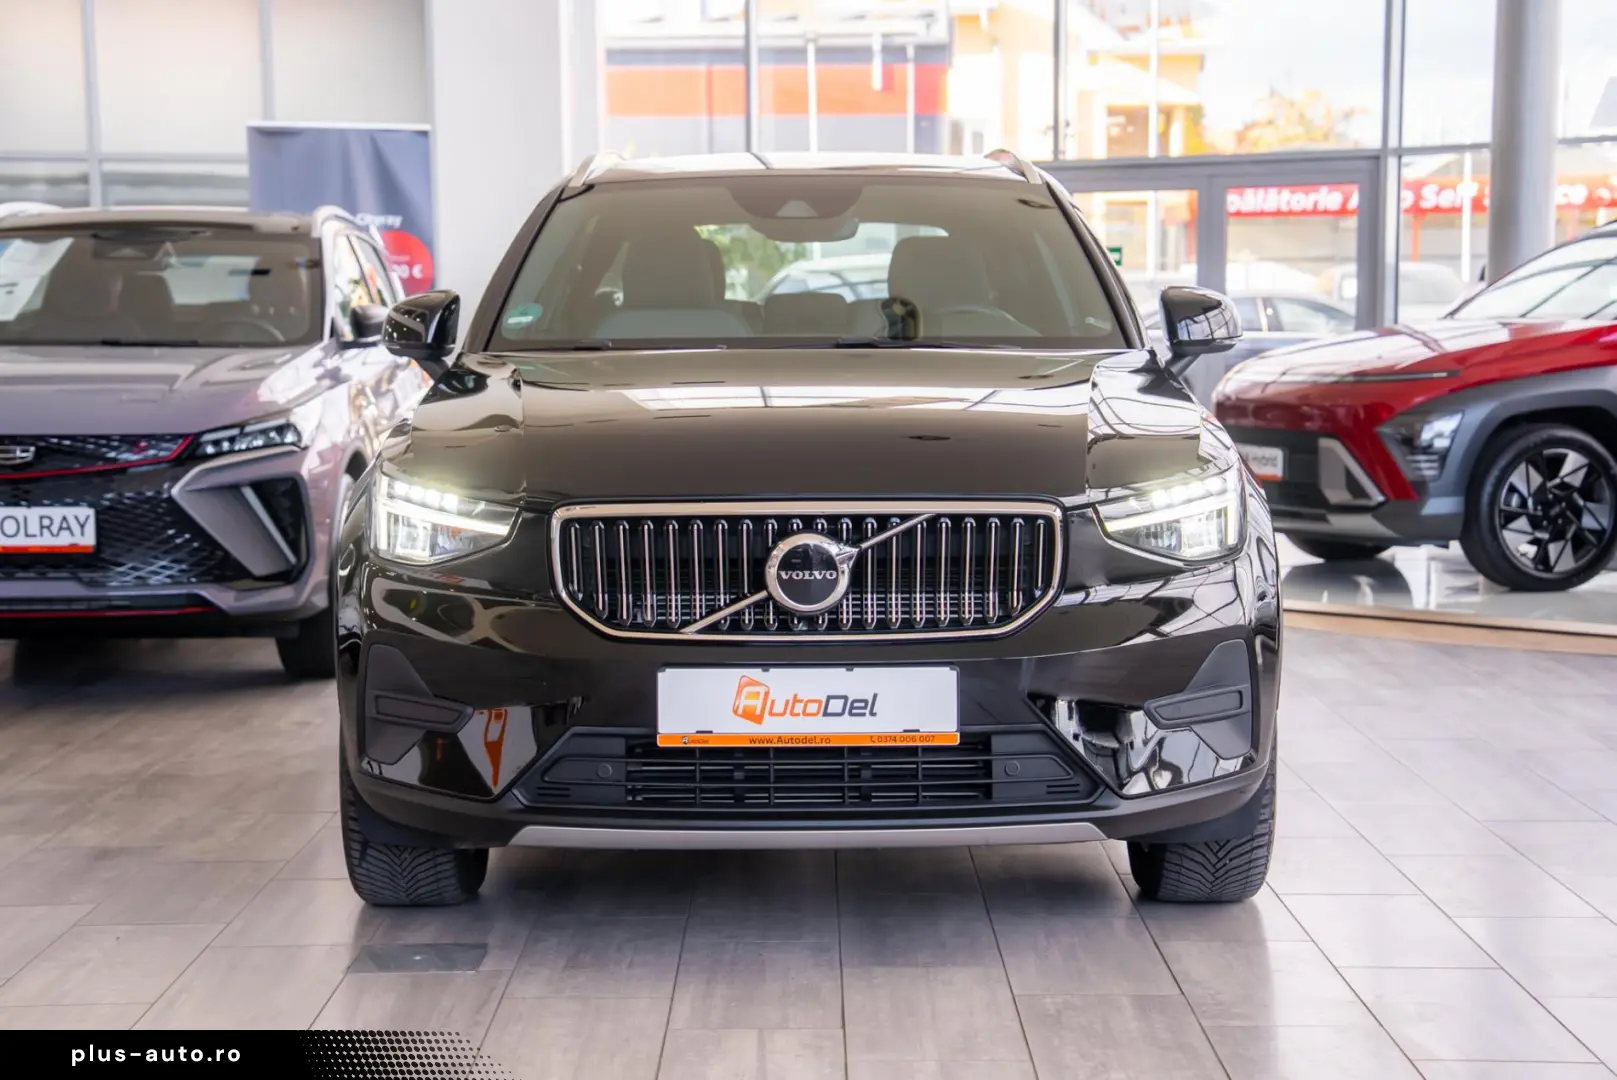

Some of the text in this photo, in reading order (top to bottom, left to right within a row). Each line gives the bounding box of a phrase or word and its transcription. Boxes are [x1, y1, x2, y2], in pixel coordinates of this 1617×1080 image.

[0, 514, 91, 538] OLRAY
[778, 570, 837, 580] VOLVO
[736, 684, 878, 718] AutoDel
[749, 736, 831, 745] www.Autodel.ro
